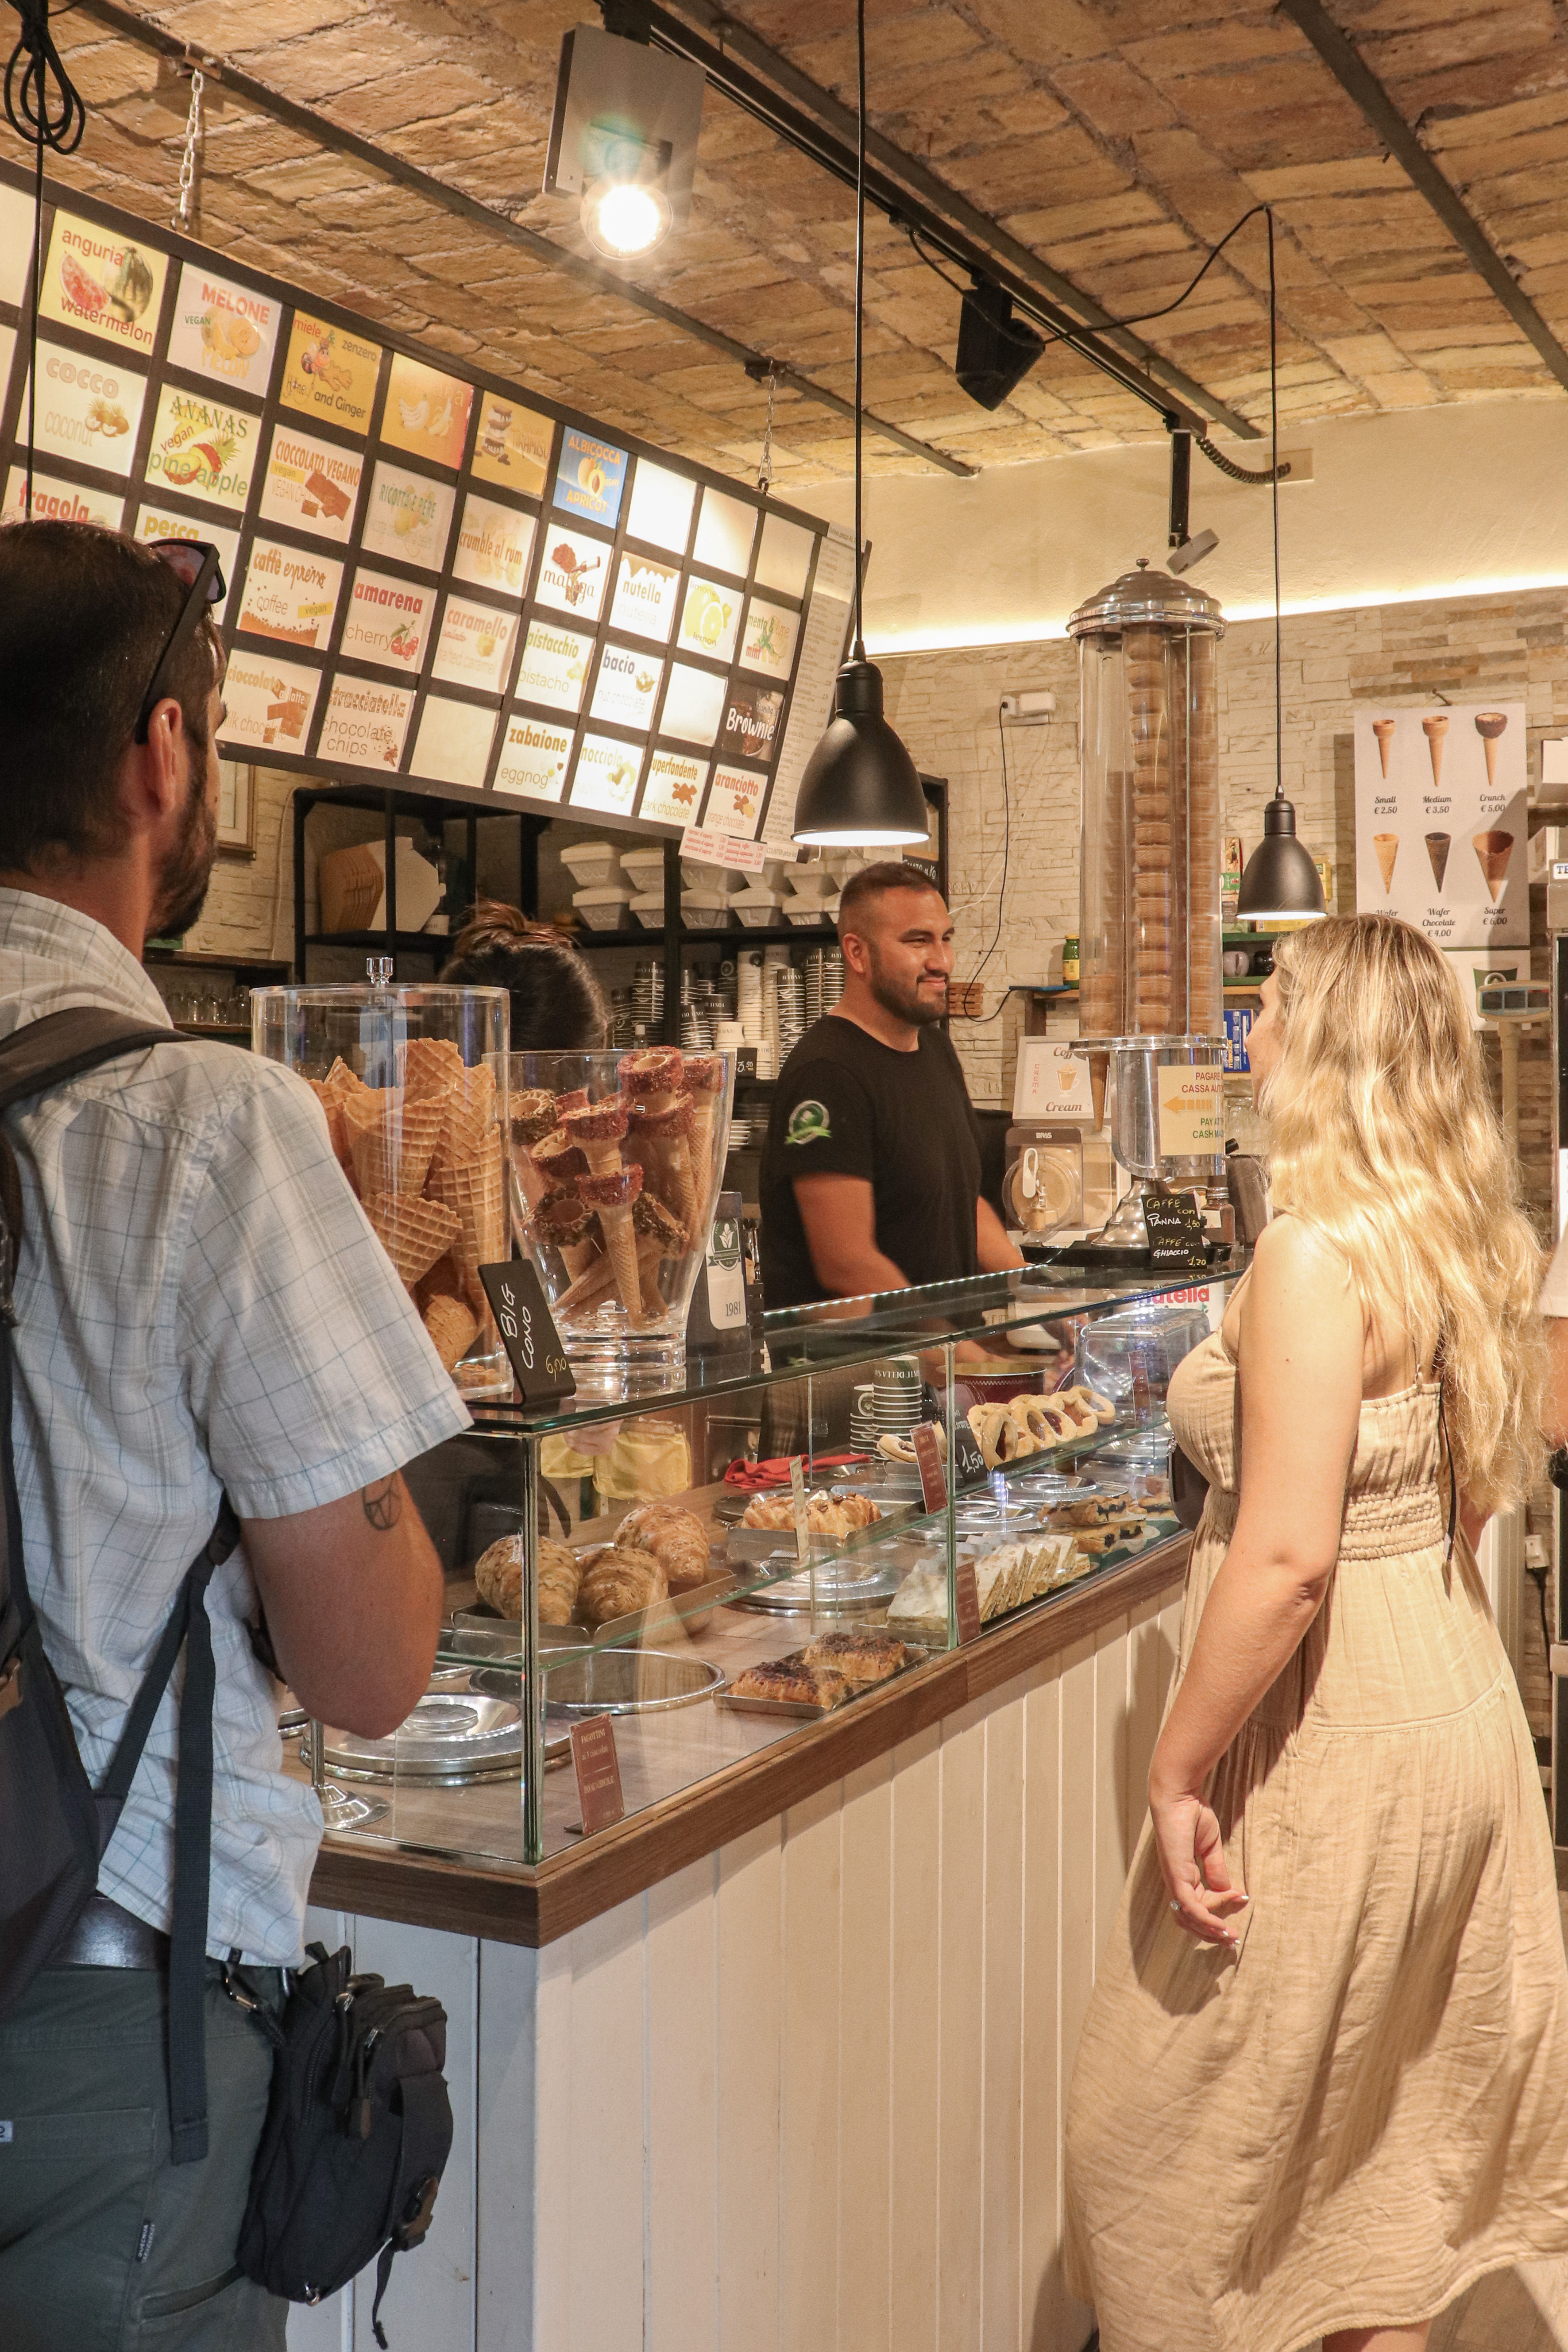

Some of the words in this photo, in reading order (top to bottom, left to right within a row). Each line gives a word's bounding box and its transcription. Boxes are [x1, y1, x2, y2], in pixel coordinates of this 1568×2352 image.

[62, 228, 124, 266] anguria
[201, 282, 270, 325] MELONE
[61, 297, 153, 345] watermelon
[184, 314, 211, 326] VEGAN
[293, 318, 321, 338] miele
[342, 339, 377, 362] zenzero
[201, 346, 250, 379] MELON
[169, 396, 248, 438] ANANAS
[314, 392, 333, 406] and
[335, 396, 366, 419] Ginger
[45, 410, 93, 448] coconut
[160, 425, 194, 452] vegan
[568, 435, 621, 466] ALBICOCCA
[148, 451, 191, 479] pine
[196, 466, 248, 496] apple
[274, 464, 296, 478] vegan
[275, 440, 324, 473] CIOCCOLATO
[327, 457, 360, 486] VEGANO
[19, 481, 90, 521] fragola
[566, 489, 608, 514] APRICOT
[144, 515, 199, 540] pesca
[459, 531, 493, 556] crumble
[494, 539, 505, 560] al
[505, 549, 523, 566] rum
[253, 548, 282, 575] caffè
[354, 582, 423, 614] amarena
[543, 569, 595, 604] malaga
[623, 579, 661, 604] nutella
[690, 580, 718, 597] limone
[256, 594, 288, 615] coffee
[305, 604, 327, 615] vegan
[446, 608, 508, 640] caramello
[345, 623, 393, 652] cherry
[525, 629, 579, 659] pistacchio
[693, 631, 717, 647] lemon
[602, 648, 635, 675] bacio
[227, 665, 282, 692] cioccolato
[288, 686, 305, 705] latte
[330, 685, 406, 718] stracciatella
[222, 711, 237, 729] ilk
[240, 717, 287, 740] chocolate
[322, 717, 393, 742] chocolate
[726, 707, 775, 741] Brownie
[327, 736, 368, 757] chips
[508, 724, 568, 753] zabaione
[580, 745, 622, 767] nocciola
[501, 767, 549, 790] eggnog
[715, 772, 759, 796] aranciotto
[641, 799, 656, 813] dark
[657, 800, 690, 819] chocolate
[1374, 795, 1397, 804] Small
[1422, 795, 1452, 803] Medium
[1479, 794, 1506, 802] Crunch
[1487, 803, 1506, 813] 5,00
[1374, 806, 1380, 815] €
[1425, 805, 1431, 814] €
[1432, 805, 1449, 815] 3,50
[1427, 908, 1451, 918] Wafer
[1484, 906, 1506, 916] Super
[1489, 916, 1507, 927] 6,00
[1422, 919, 1456, 927] Chocolate
[1434, 929, 1452, 938] 4,00
[1053, 1047, 1073, 1059] Coff
[1196, 1072, 1220, 1081] PAGARE
[1182, 1084, 1210, 1093] CASSA
[1211, 1085, 1224, 1093] AUTO
[1046, 1101, 1082, 1112] Cream
[1201, 1118, 1213, 1126] PAY
[1214, 1117, 1220, 1126] AT
[1193, 1130, 1213, 1139] CASH
[1214, 1130, 1224, 1138] MAC
[1147, 1213, 1182, 1227] PANNA
[1153, 1249, 1189, 1259] GHIACCIO
[500, 1282, 516, 1339] BIG
[726, 1301, 741, 1317] 1981
[521, 1305, 535, 1370] CONO
